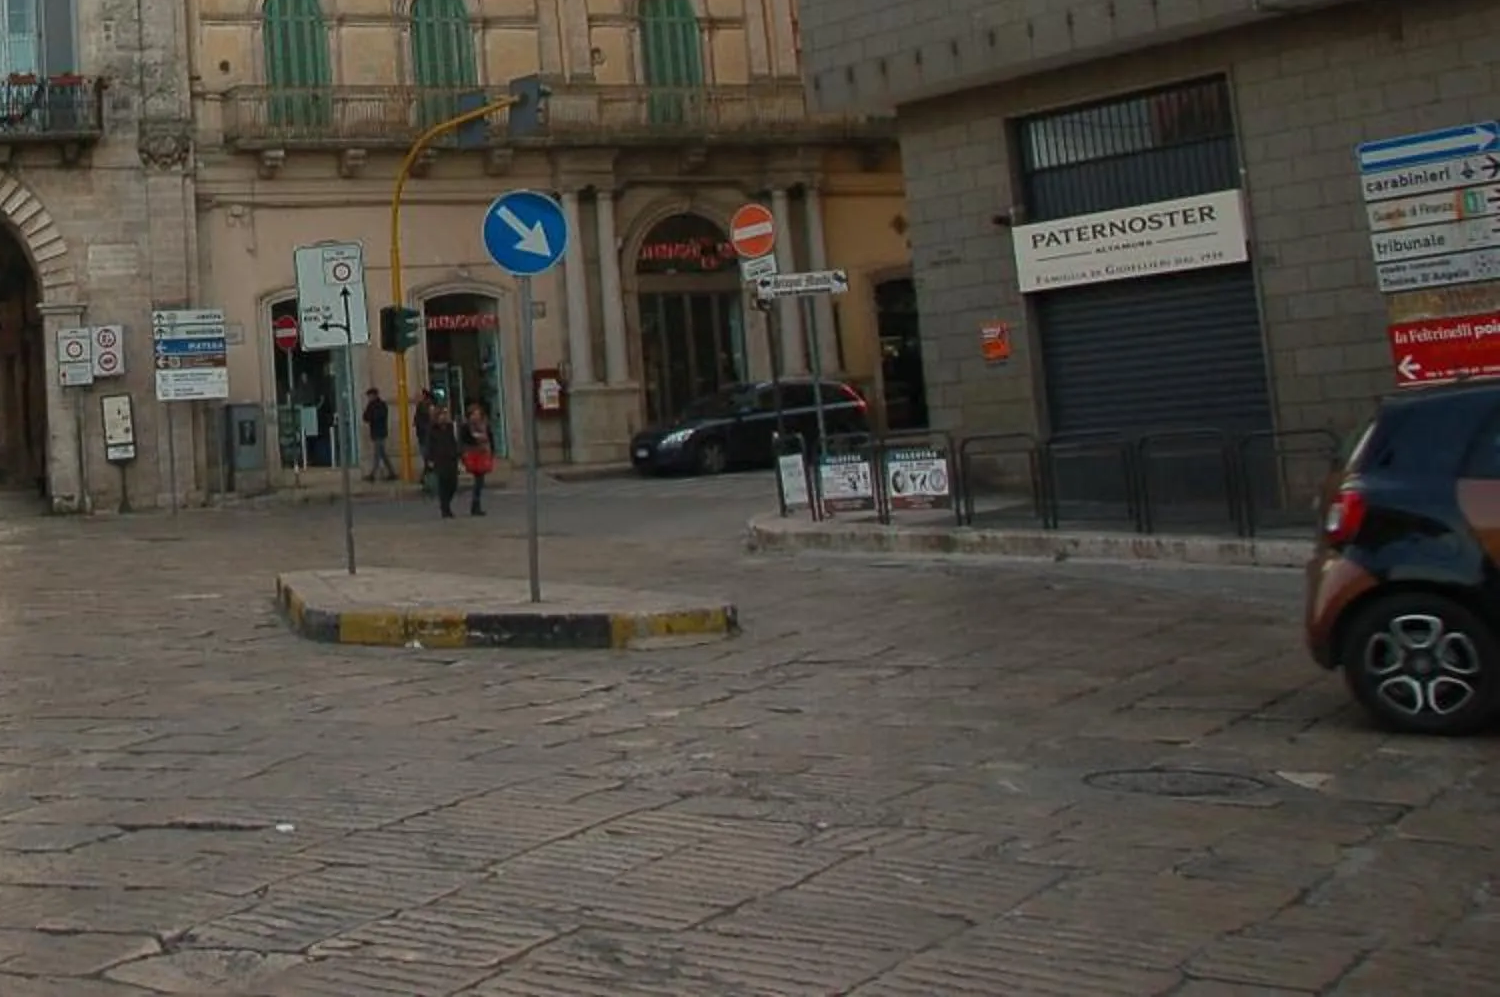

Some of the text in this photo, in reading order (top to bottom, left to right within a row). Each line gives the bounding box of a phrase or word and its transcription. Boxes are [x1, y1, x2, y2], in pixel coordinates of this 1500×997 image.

[1367, 168, 1450, 192] carabinieri
[1032, 205, 1216, 249] PATERNOSTER
[1377, 234, 1445, 254] tribunale
[1409, 322, 1472, 343] Feltrinelli
